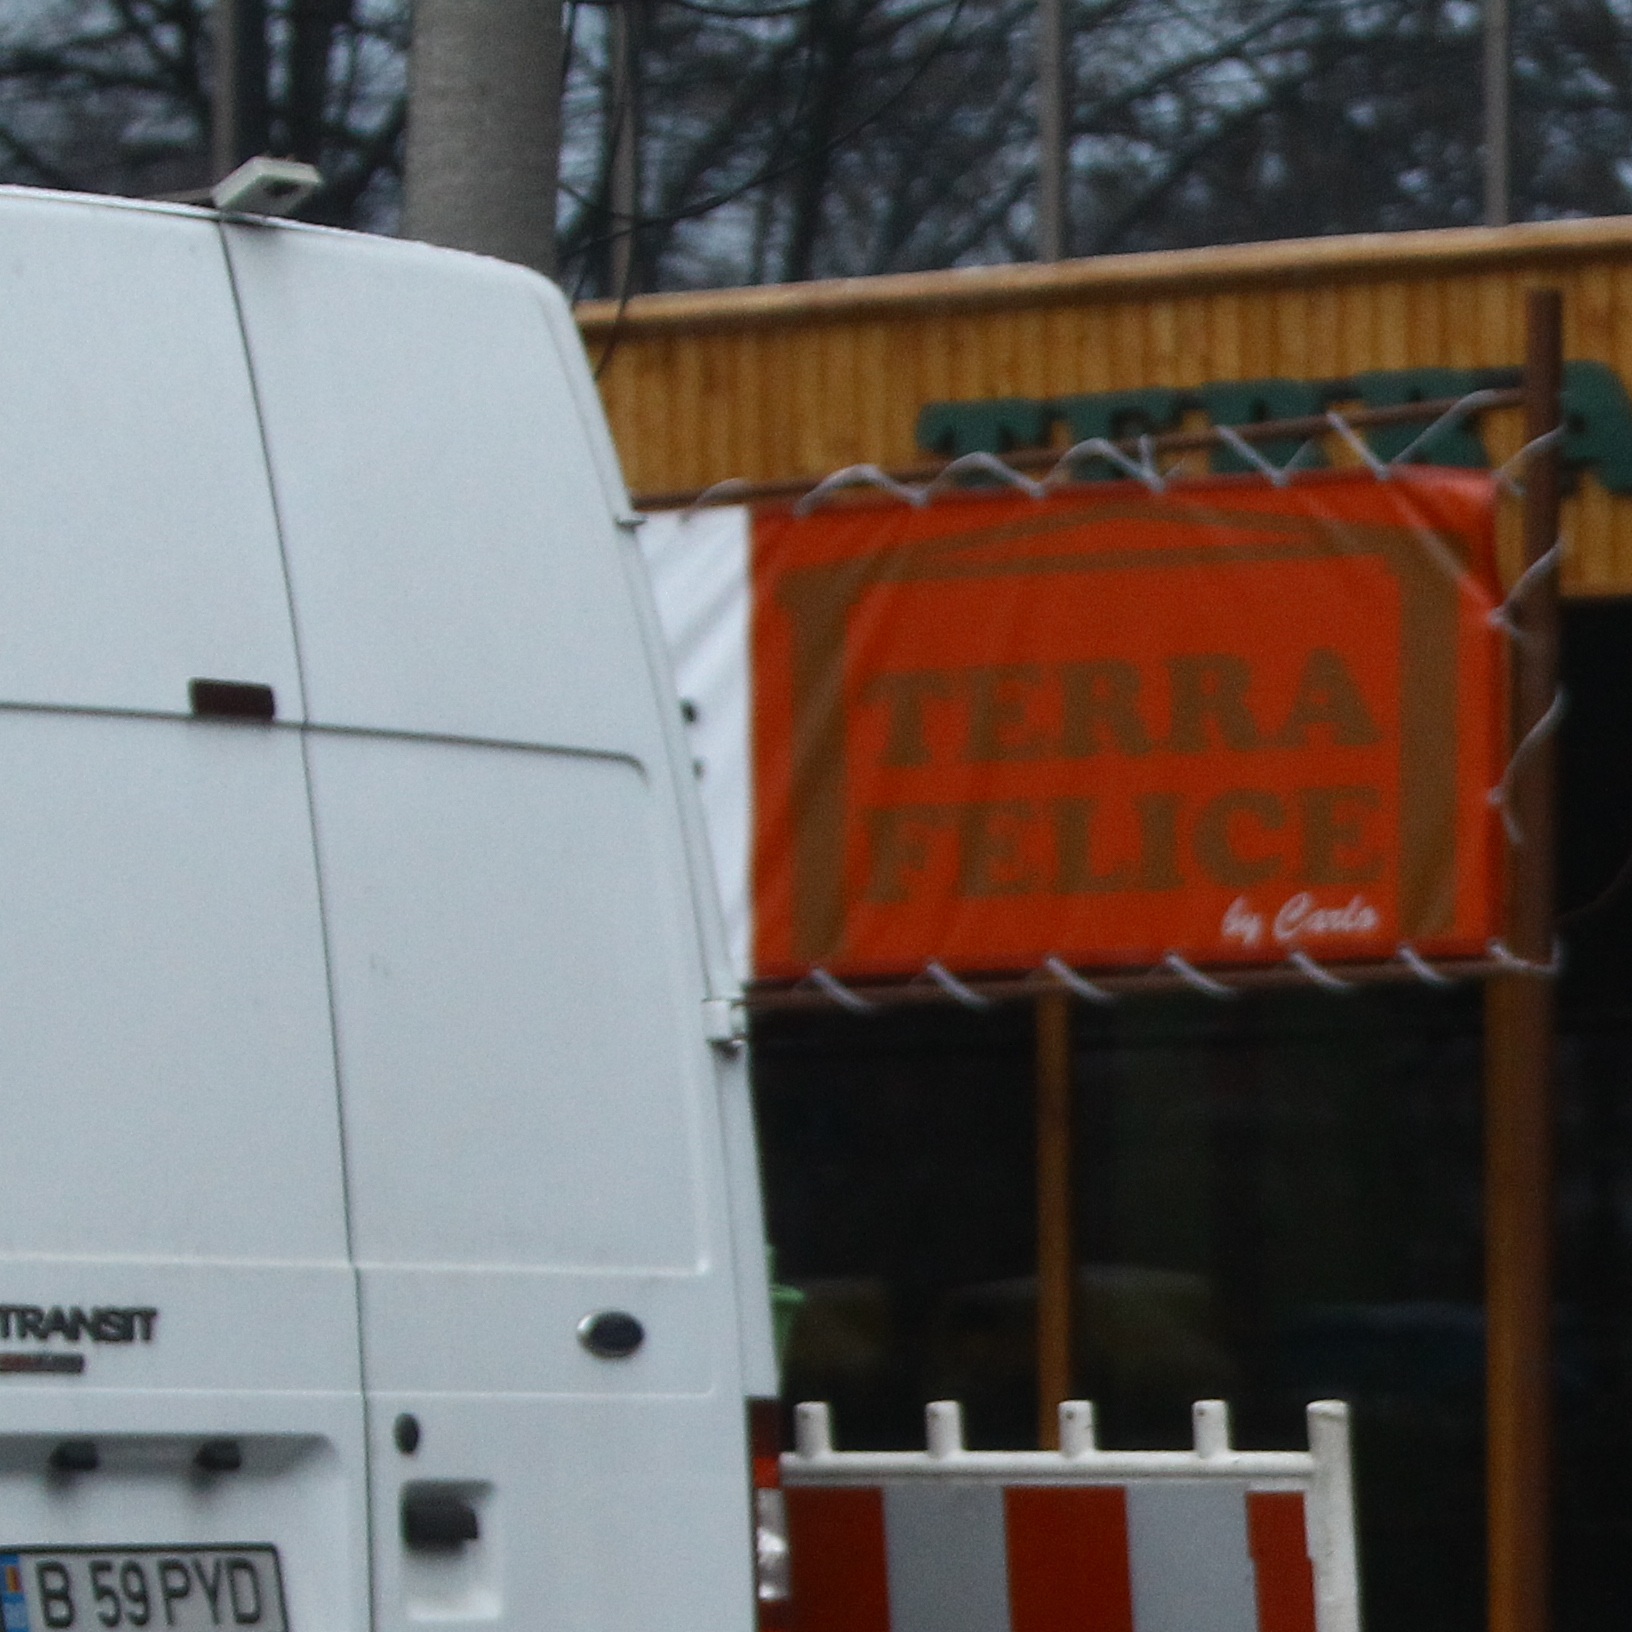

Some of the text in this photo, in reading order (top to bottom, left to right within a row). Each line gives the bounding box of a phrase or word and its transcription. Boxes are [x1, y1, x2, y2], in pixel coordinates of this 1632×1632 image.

[862, 648, 1382, 769] TERRA
[862, 784, 1388, 904] FELICE
[0, 1305, 157, 1342] TRANSIT
[36, 1557, 261, 1629] B 59 PYD
